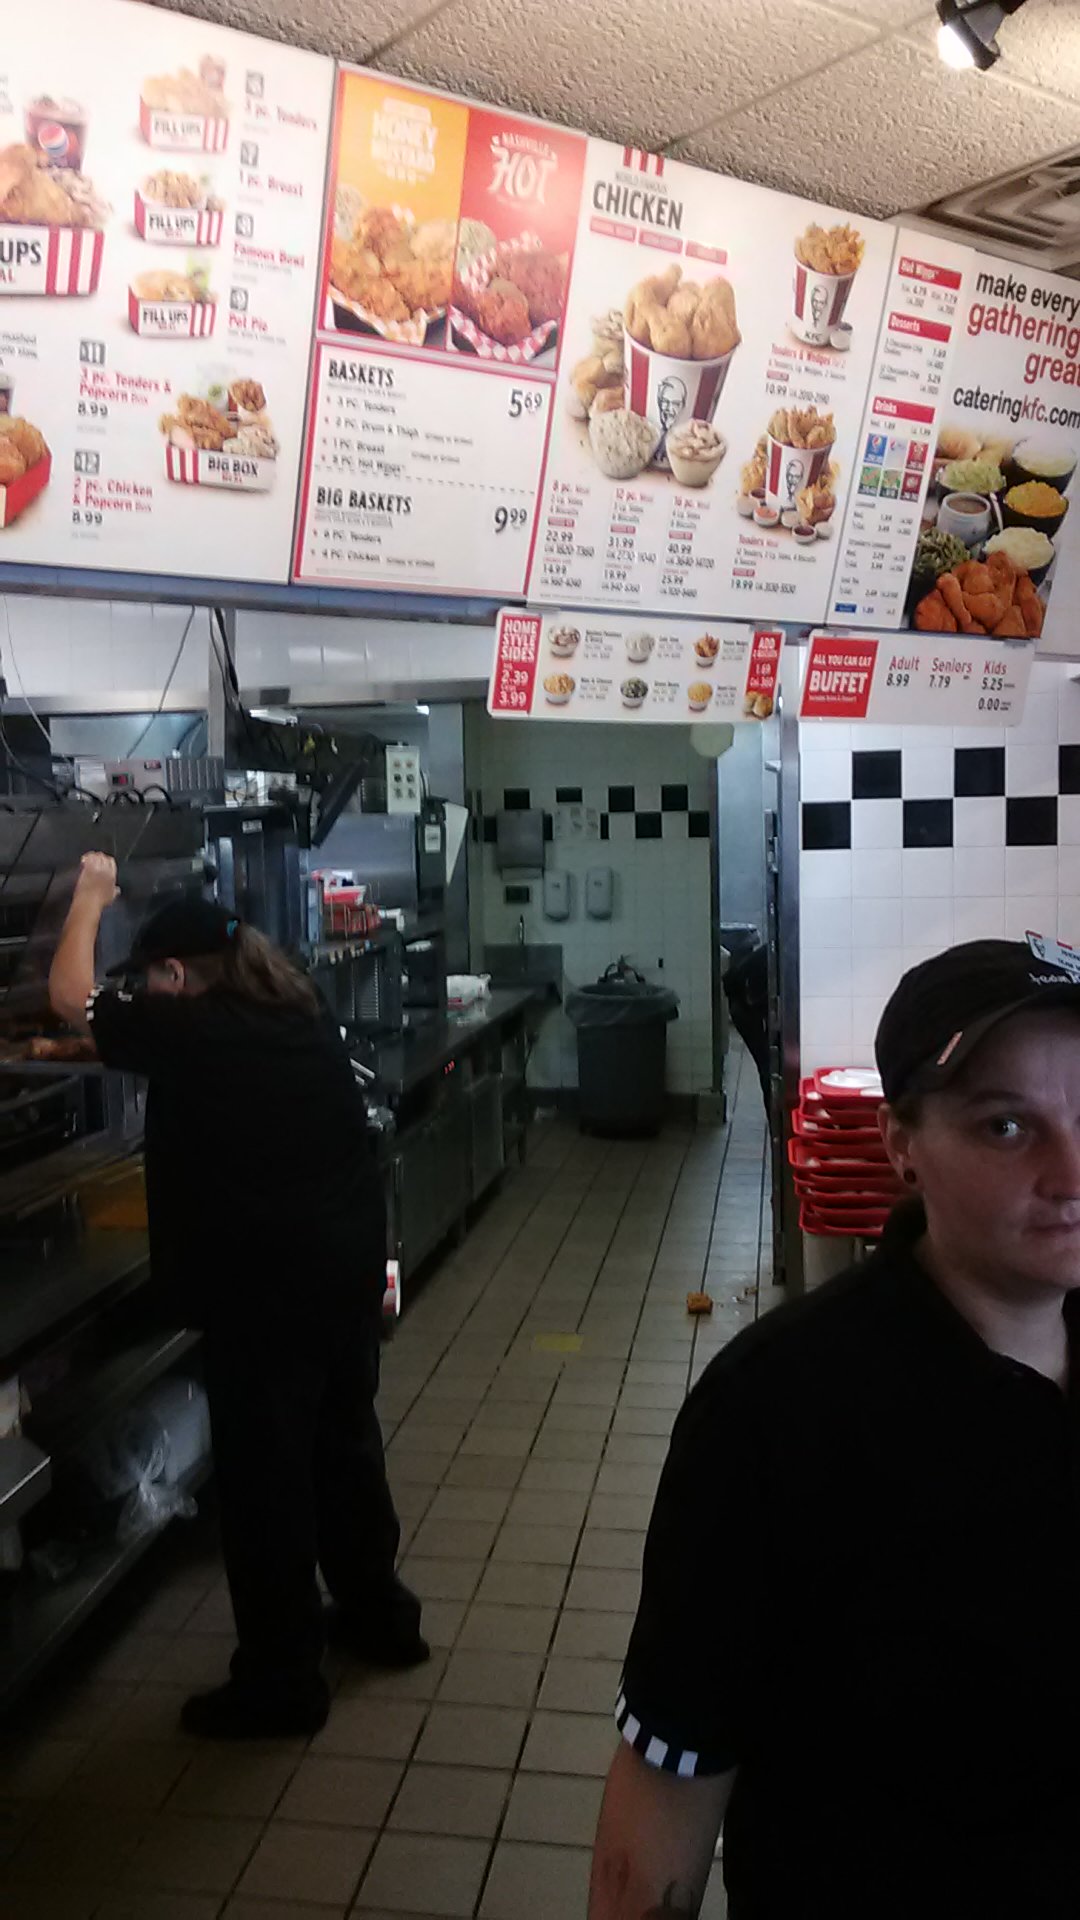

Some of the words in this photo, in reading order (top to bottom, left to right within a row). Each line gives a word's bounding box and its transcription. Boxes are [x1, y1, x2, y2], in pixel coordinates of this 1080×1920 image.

[487, 138, 558, 204] HOT
[593, 180, 683, 231] CHICKEN
[149, 214, 173, 231] FILL
[175, 216, 196, 230] UPS
[234, 240, 275, 262] Famous
[976, 272, 1027, 303] make
[1030, 287, 1080, 322] every
[143, 307, 167, 323] FILL
[169, 309, 189, 323] UPS
[891, 315, 920, 332] Desserts
[967, 303, 1080, 359] gathering
[115, 372, 160, 392] Tenders
[328, 359, 394, 388] BASKETS
[79, 382, 129, 403] Popcorn
[875, 399, 898, 415] Drinks
[953, 385, 1080, 430] cateringkfc.com
[208, 455, 229, 470] BIG
[233, 459, 258, 477] BOX
[107, 479, 153, 498] Chicken
[85, 494, 132, 512] Popcorn
[317, 486, 343, 506] BIG
[349, 489, 413, 515] BASKETS
[504, 619, 538, 634] HOME
[503, 633, 537, 648] STYLE
[758, 637, 776, 649] ADD
[501, 646, 535, 663] SIDES
[813, 653, 826, 666] ALL
[828, 654, 843, 666] YOU
[843, 655, 858, 667] CAN
[858, 656, 873, 668] EAT
[889, 655, 920, 672] Adult
[932, 657, 972, 674] Seniors
[984, 660, 1007, 676] Kids
[501, 669, 529, 686] 2.39
[809, 670, 869, 695] BUFFET
[886, 673, 910, 687] 8.99
[929, 674, 951, 689] 7.79
[981, 676, 1003, 691] 5.25
[499, 690, 527, 708] 3.99
[978, 697, 1000, 711] 0.00
